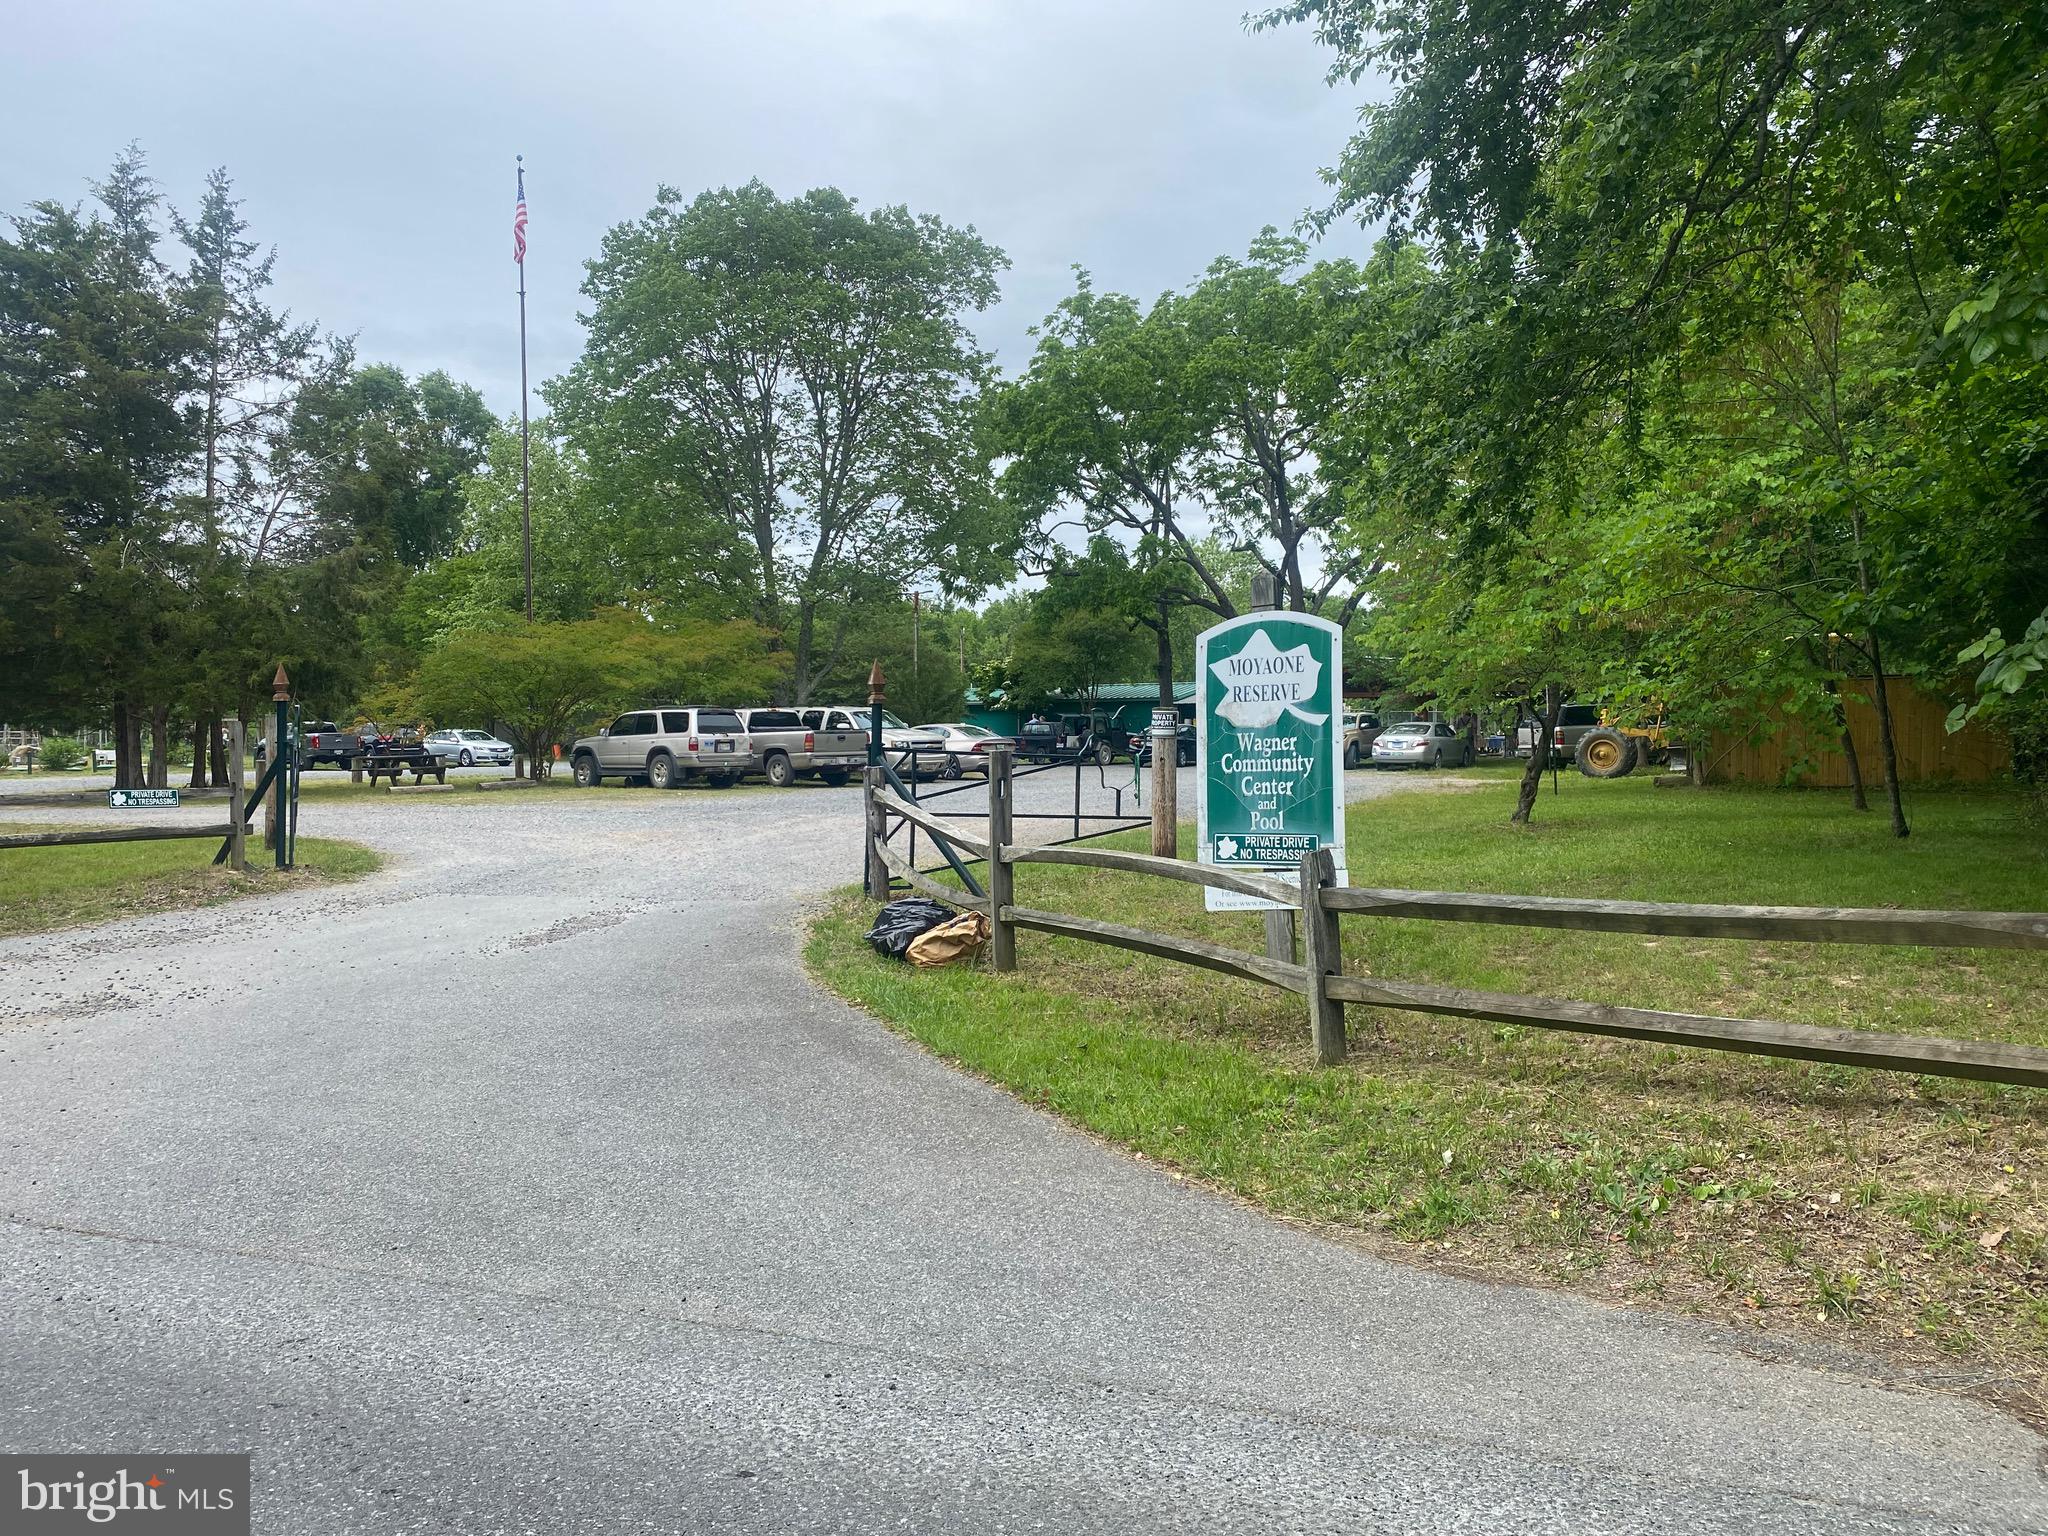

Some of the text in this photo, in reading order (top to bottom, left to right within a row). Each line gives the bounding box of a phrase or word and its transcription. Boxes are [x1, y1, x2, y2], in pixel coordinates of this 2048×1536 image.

[1229, 655, 1305, 676] MOYAONE
[1233, 683, 1300, 702] RESERVE
[1237, 732, 1297, 757] Wagner
[1221, 751, 1314, 778] Community
[1241, 776, 1294, 796] Center
[1257, 796, 1277, 810] and
[1249, 811, 1284, 831] Pool
[1245, 836, 1310, 848] PRIVATE DRIVE
[1240, 848, 1314, 861] NO TRESPASSI
